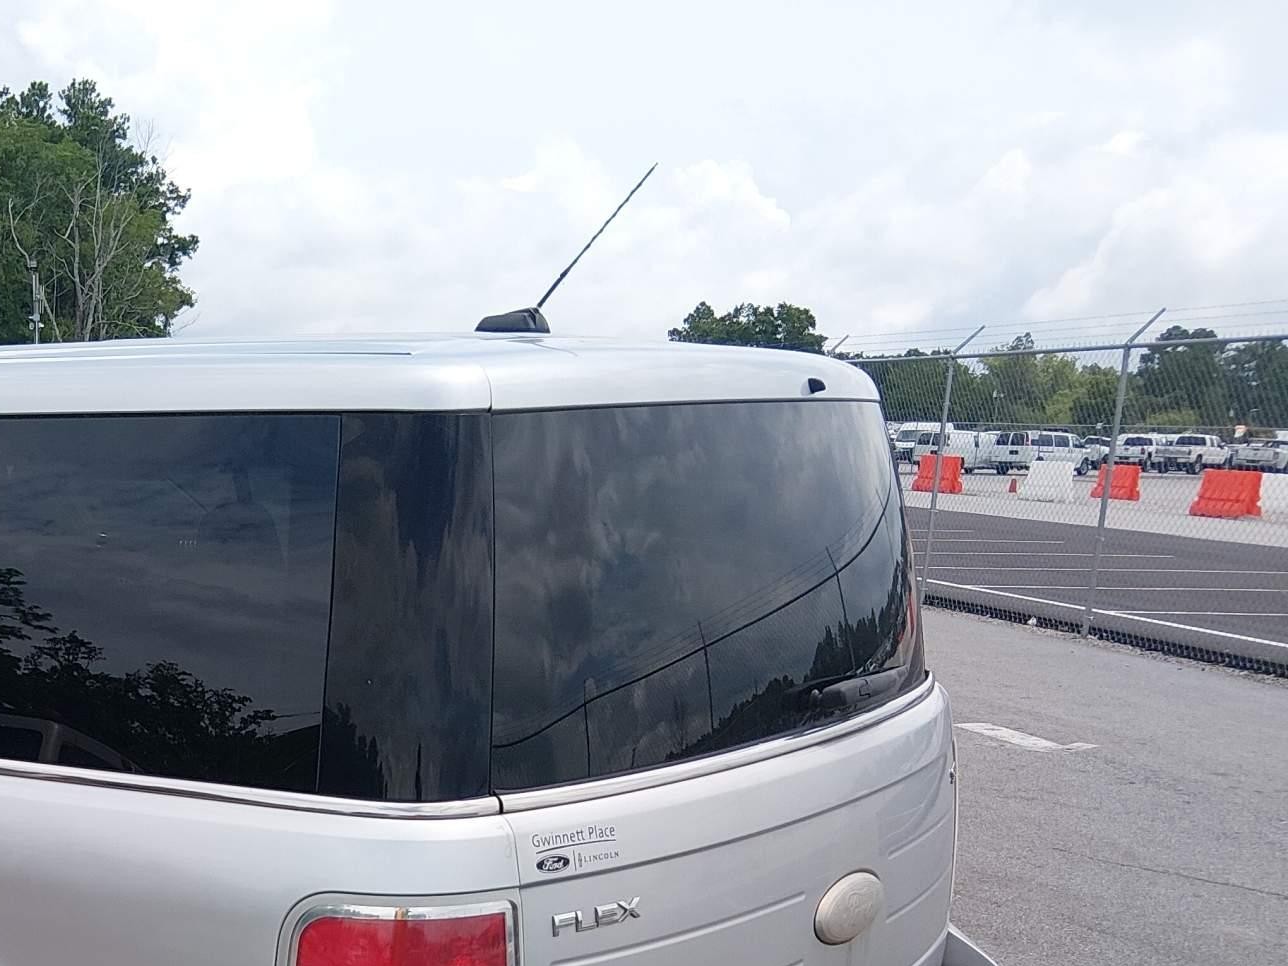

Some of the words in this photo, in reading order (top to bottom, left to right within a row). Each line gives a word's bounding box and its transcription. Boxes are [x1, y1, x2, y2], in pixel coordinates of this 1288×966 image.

[532, 829, 585, 848] Gwinnett
[588, 825, 616, 840] Place
[584, 850, 620, 863] LINCOLN
[552, 896, 641, 937] FLEX
